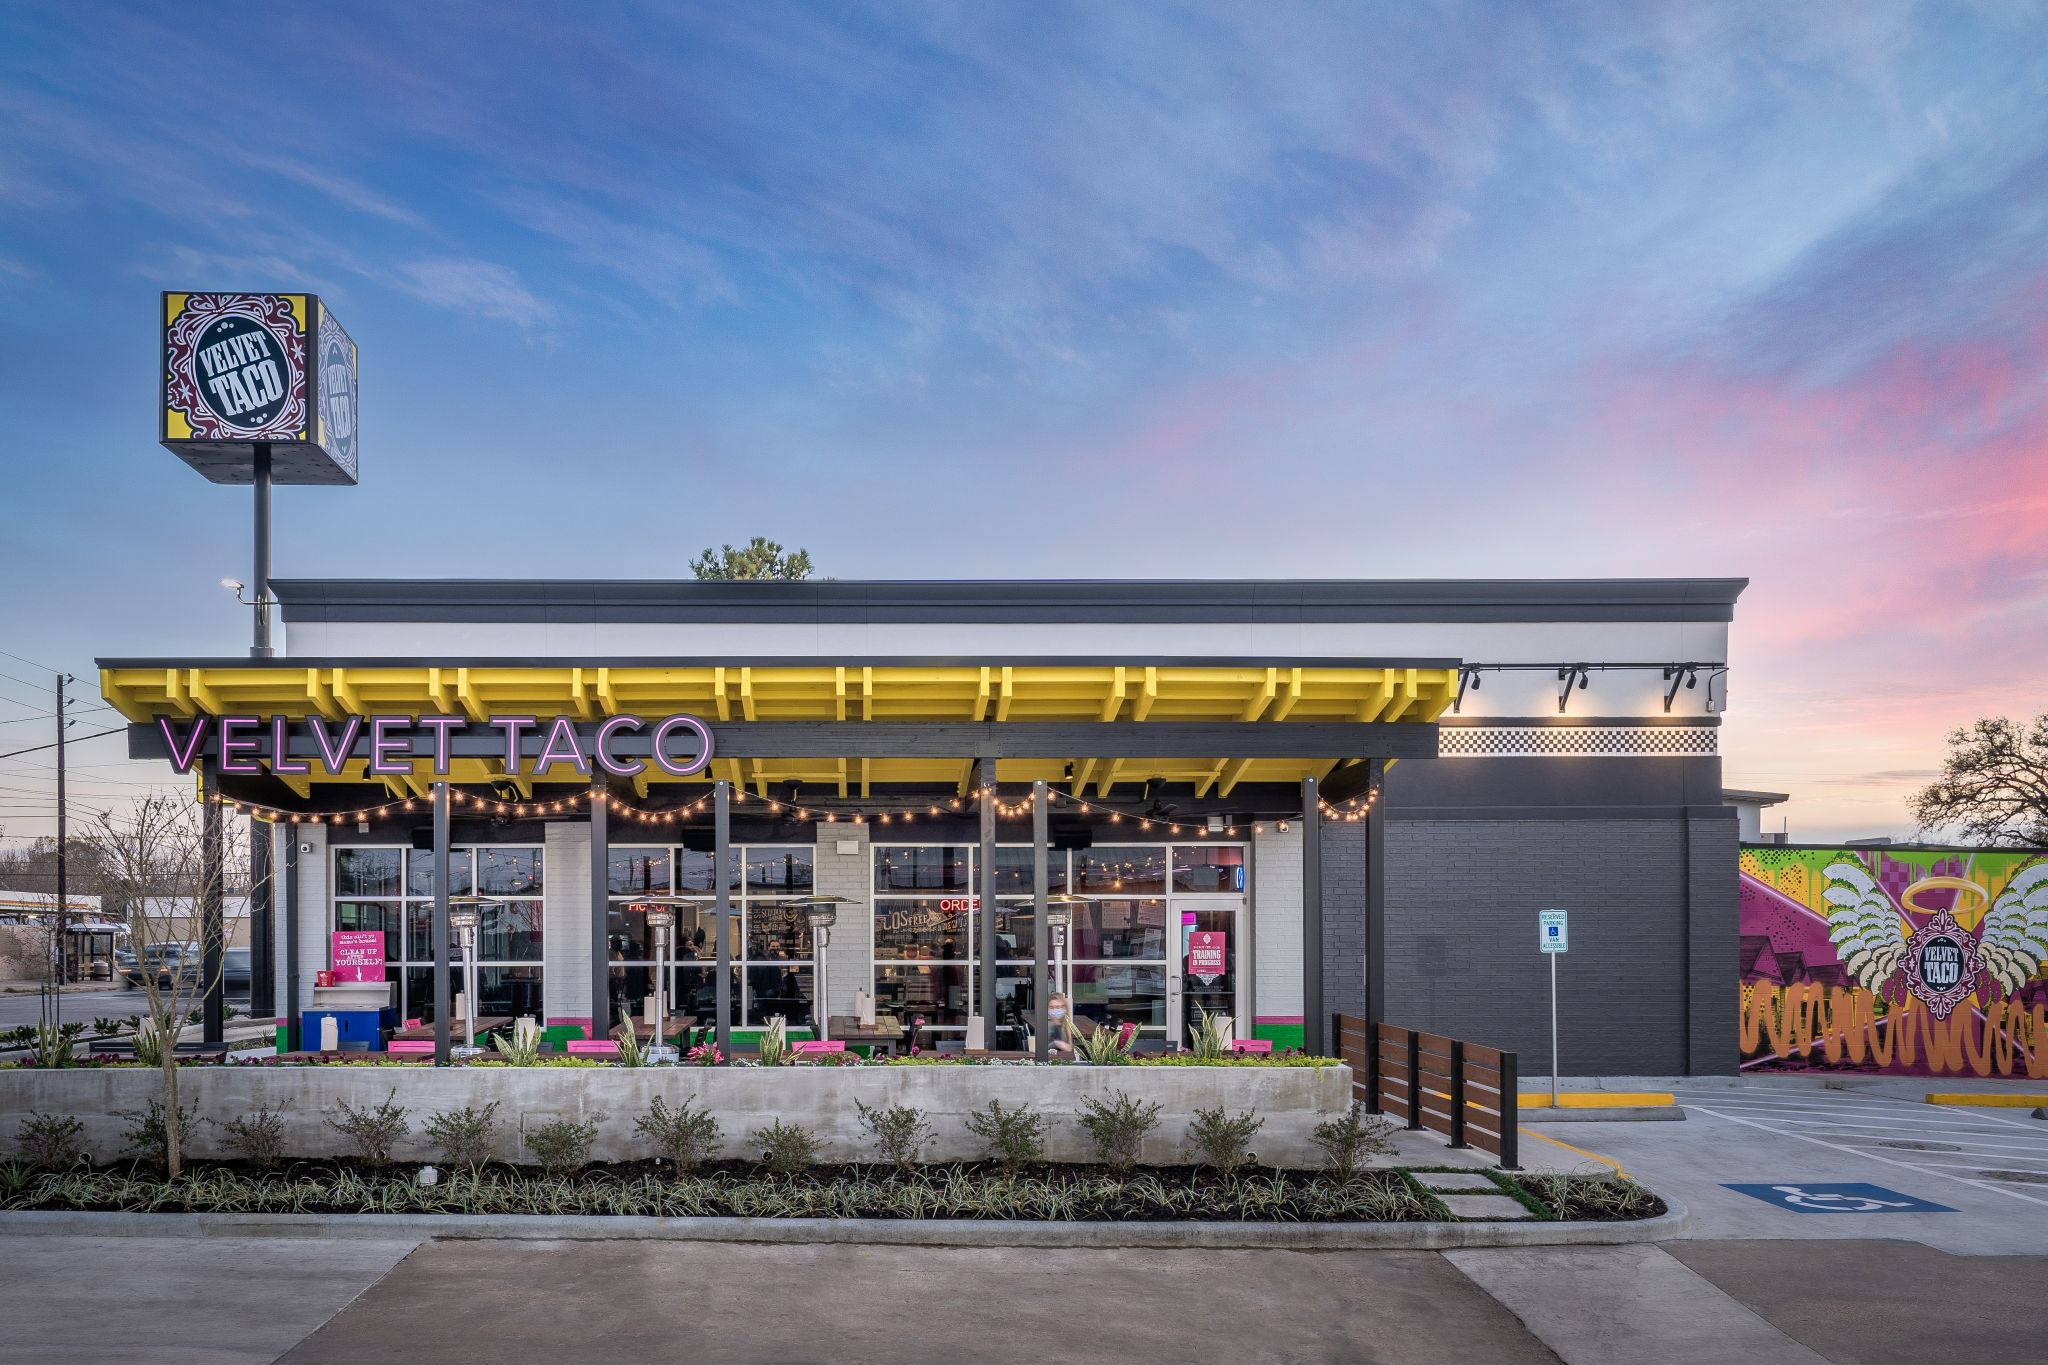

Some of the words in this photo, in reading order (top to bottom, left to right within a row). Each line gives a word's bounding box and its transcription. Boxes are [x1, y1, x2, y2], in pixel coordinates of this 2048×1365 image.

[199, 331, 271, 377] VELVET
[208, 359, 283, 416] TACO
[152, 715, 466, 775] VELVET
[488, 713, 715, 776] TACO
[940, 900, 980, 911] ORDE
[1192, 950, 1221, 959] TRAINING
[1924, 946, 1959, 962] VELVET
[1924, 962, 1958, 983] TACO
